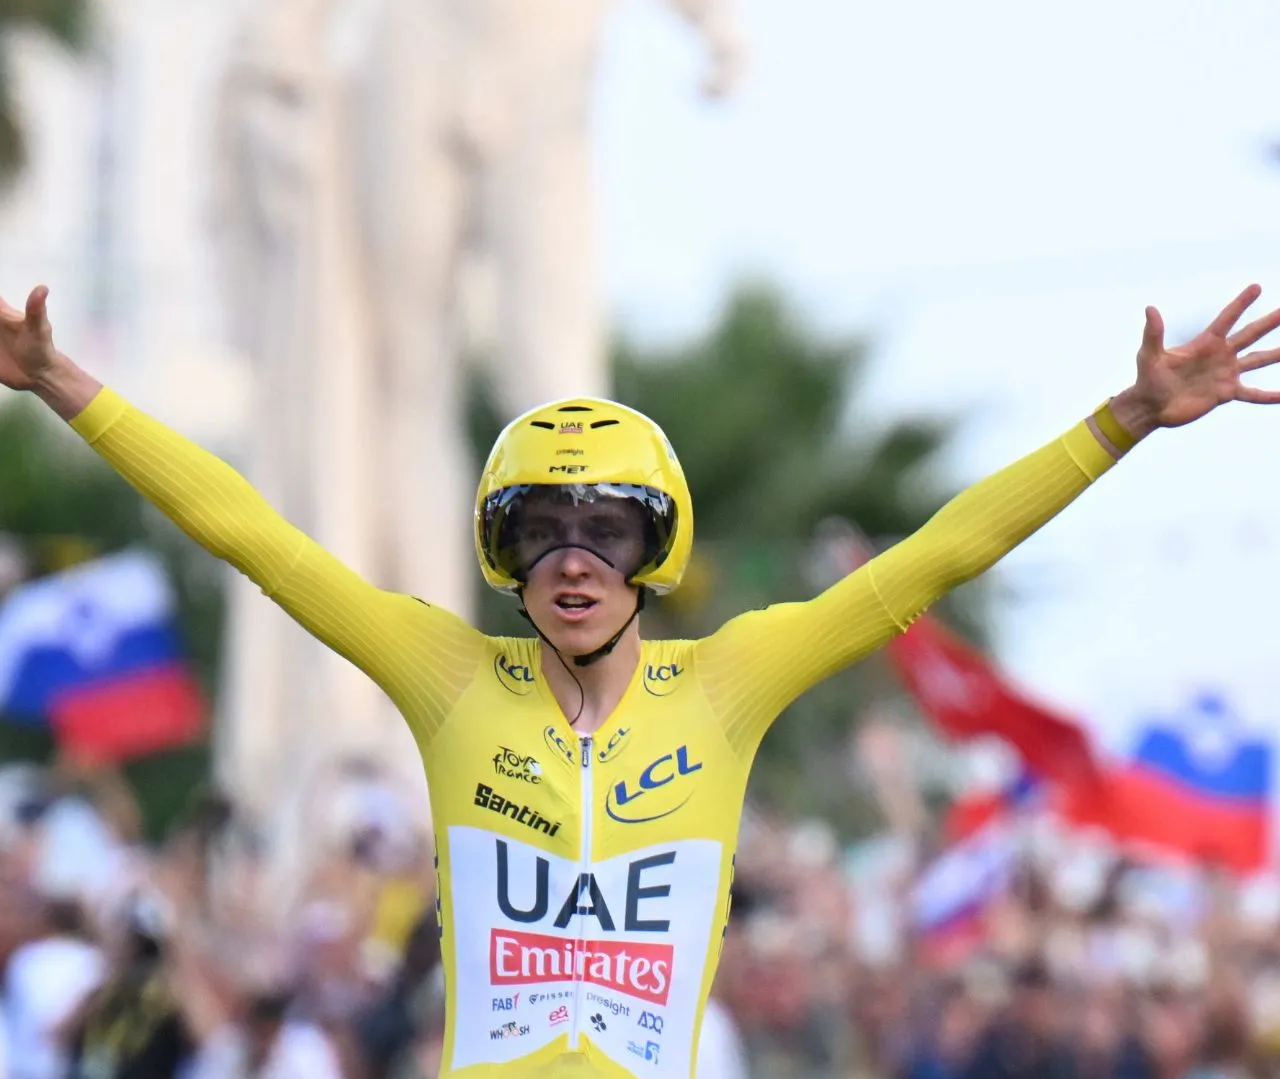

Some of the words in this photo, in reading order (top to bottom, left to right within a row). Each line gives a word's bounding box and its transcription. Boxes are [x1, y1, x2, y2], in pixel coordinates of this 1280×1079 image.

[548, 465, 589, 474] MET
[499, 655, 535, 682] LCL
[647, 663, 685, 681] LCL
[614, 745, 703, 806] LCL
[474, 783, 562, 837] Santini
[495, 839, 678, 933] UAE
[496, 936, 669, 996] Emirates
[586, 992, 630, 1016] presight
